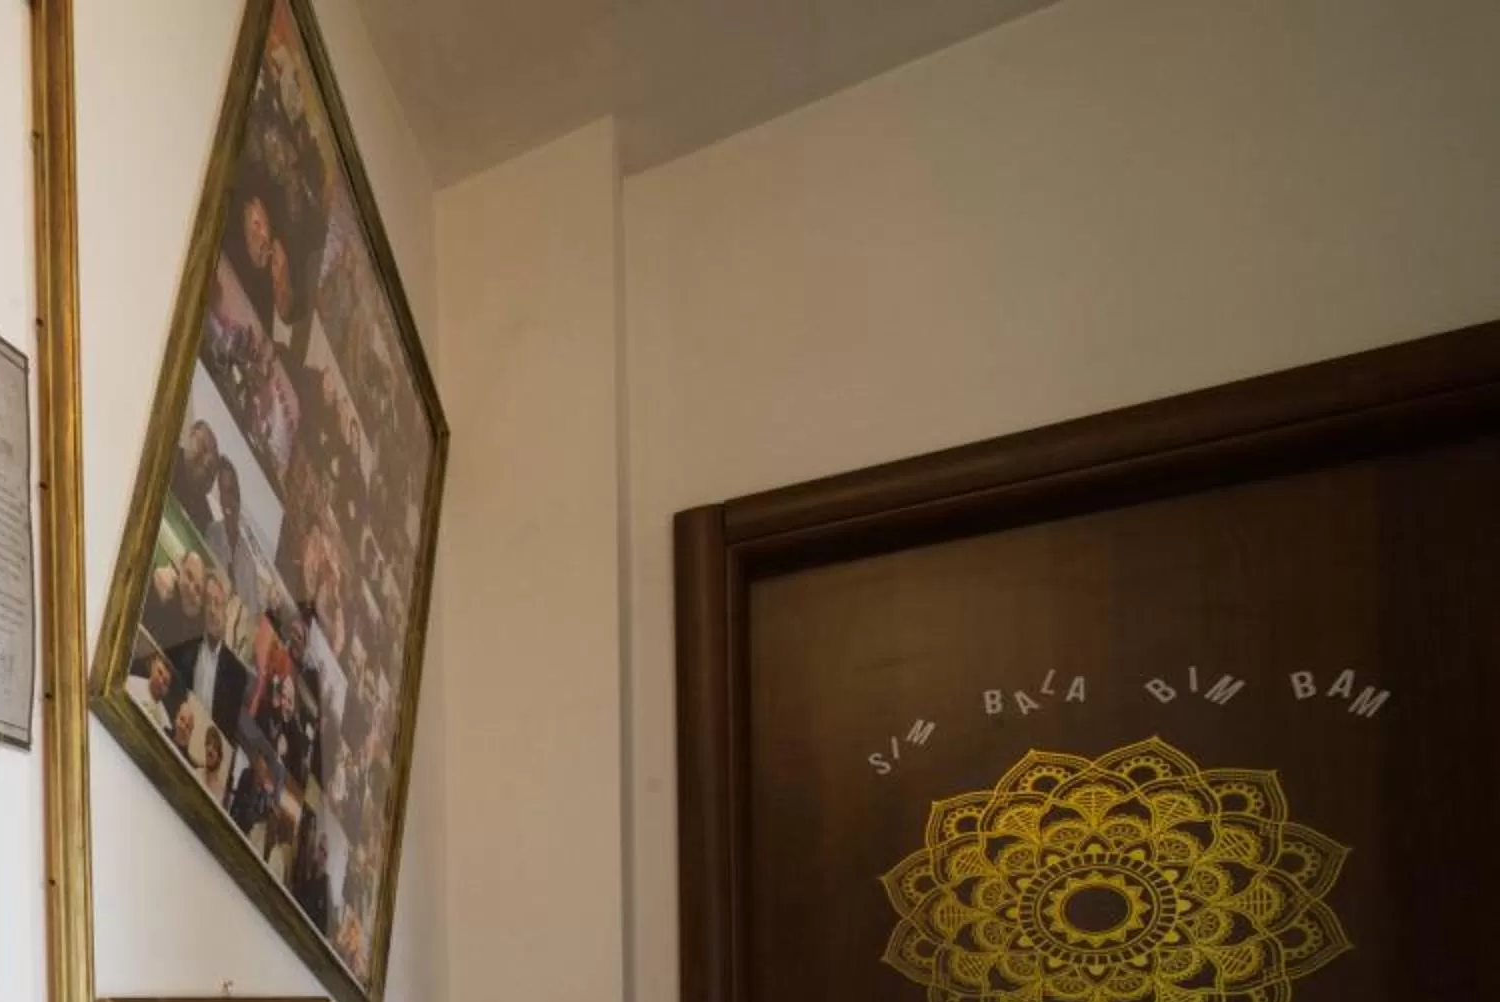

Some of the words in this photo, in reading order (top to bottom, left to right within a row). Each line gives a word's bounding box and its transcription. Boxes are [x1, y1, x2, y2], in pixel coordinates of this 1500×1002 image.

[868, 719, 936, 775] SIM
[984, 668, 1087, 716] BALA
[1144, 666, 1247, 705] BIM
[1288, 669, 1391, 719] BAM
